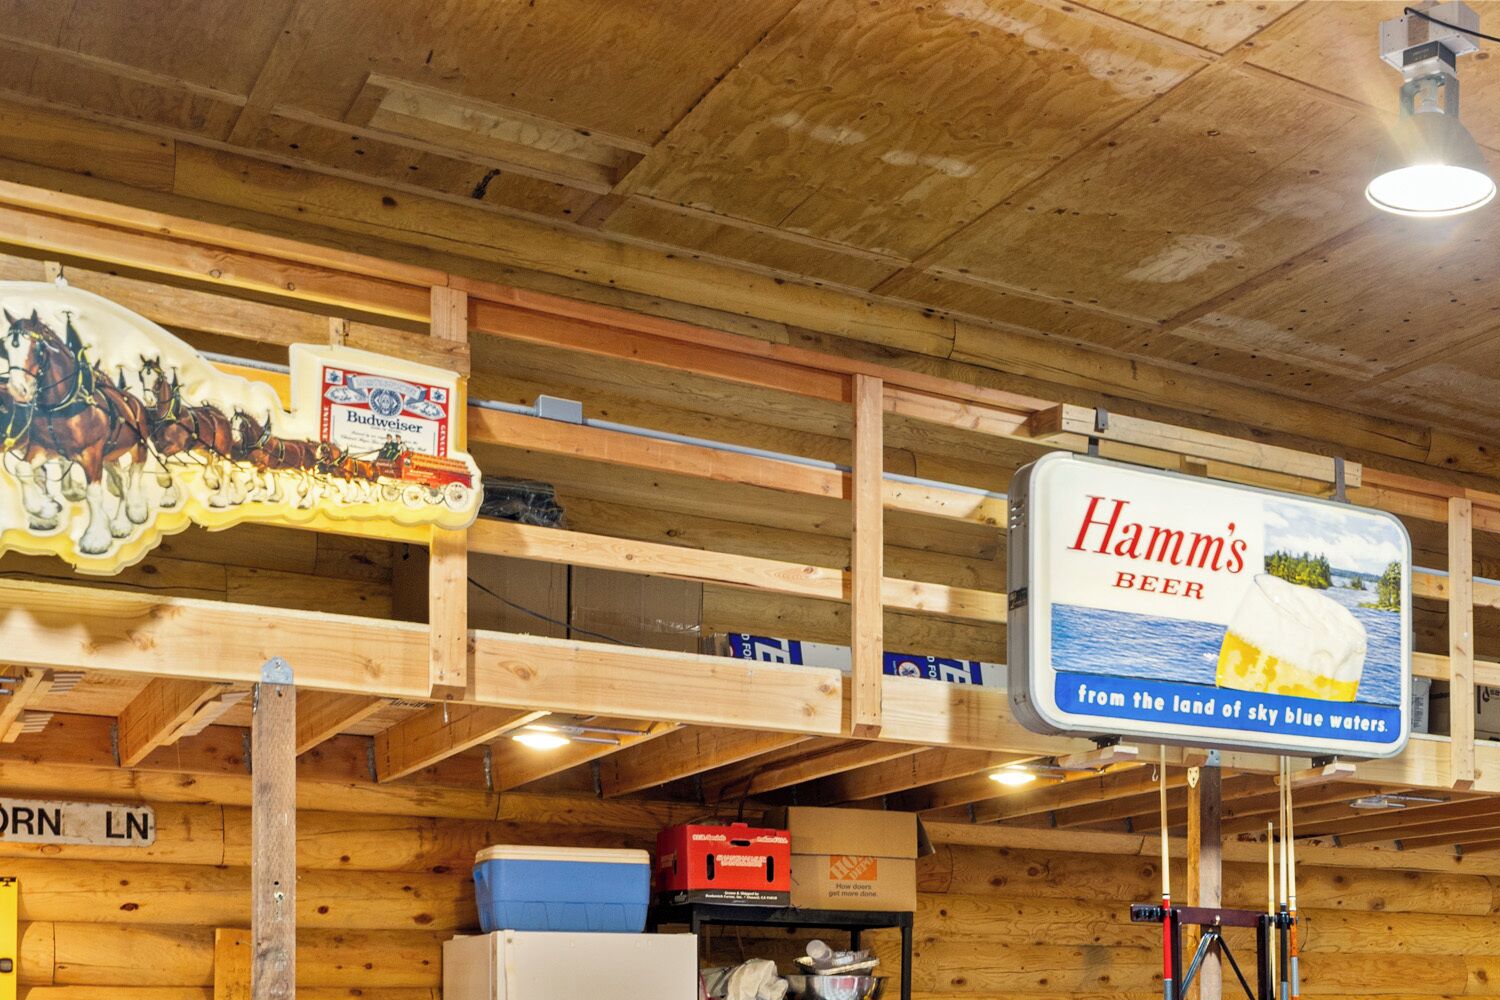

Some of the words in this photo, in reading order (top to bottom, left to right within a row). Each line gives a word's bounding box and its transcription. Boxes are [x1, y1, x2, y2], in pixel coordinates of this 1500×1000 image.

[346, 410, 423, 433] Budweiser
[1066, 495, 1247, 574] Hamm's
[1112, 571, 1204, 600] BEER
[1078, 684, 1125, 707] from
[1133, 692, 1164, 711] the
[1173, 695, 1215, 716] land
[1222, 700, 1241, 718] of
[1248, 703, 1278, 726] sky
[1284, 706, 1323, 727] blue
[1330, 715, 1388, 733] waters.
[106, 811, 148, 840] LN
